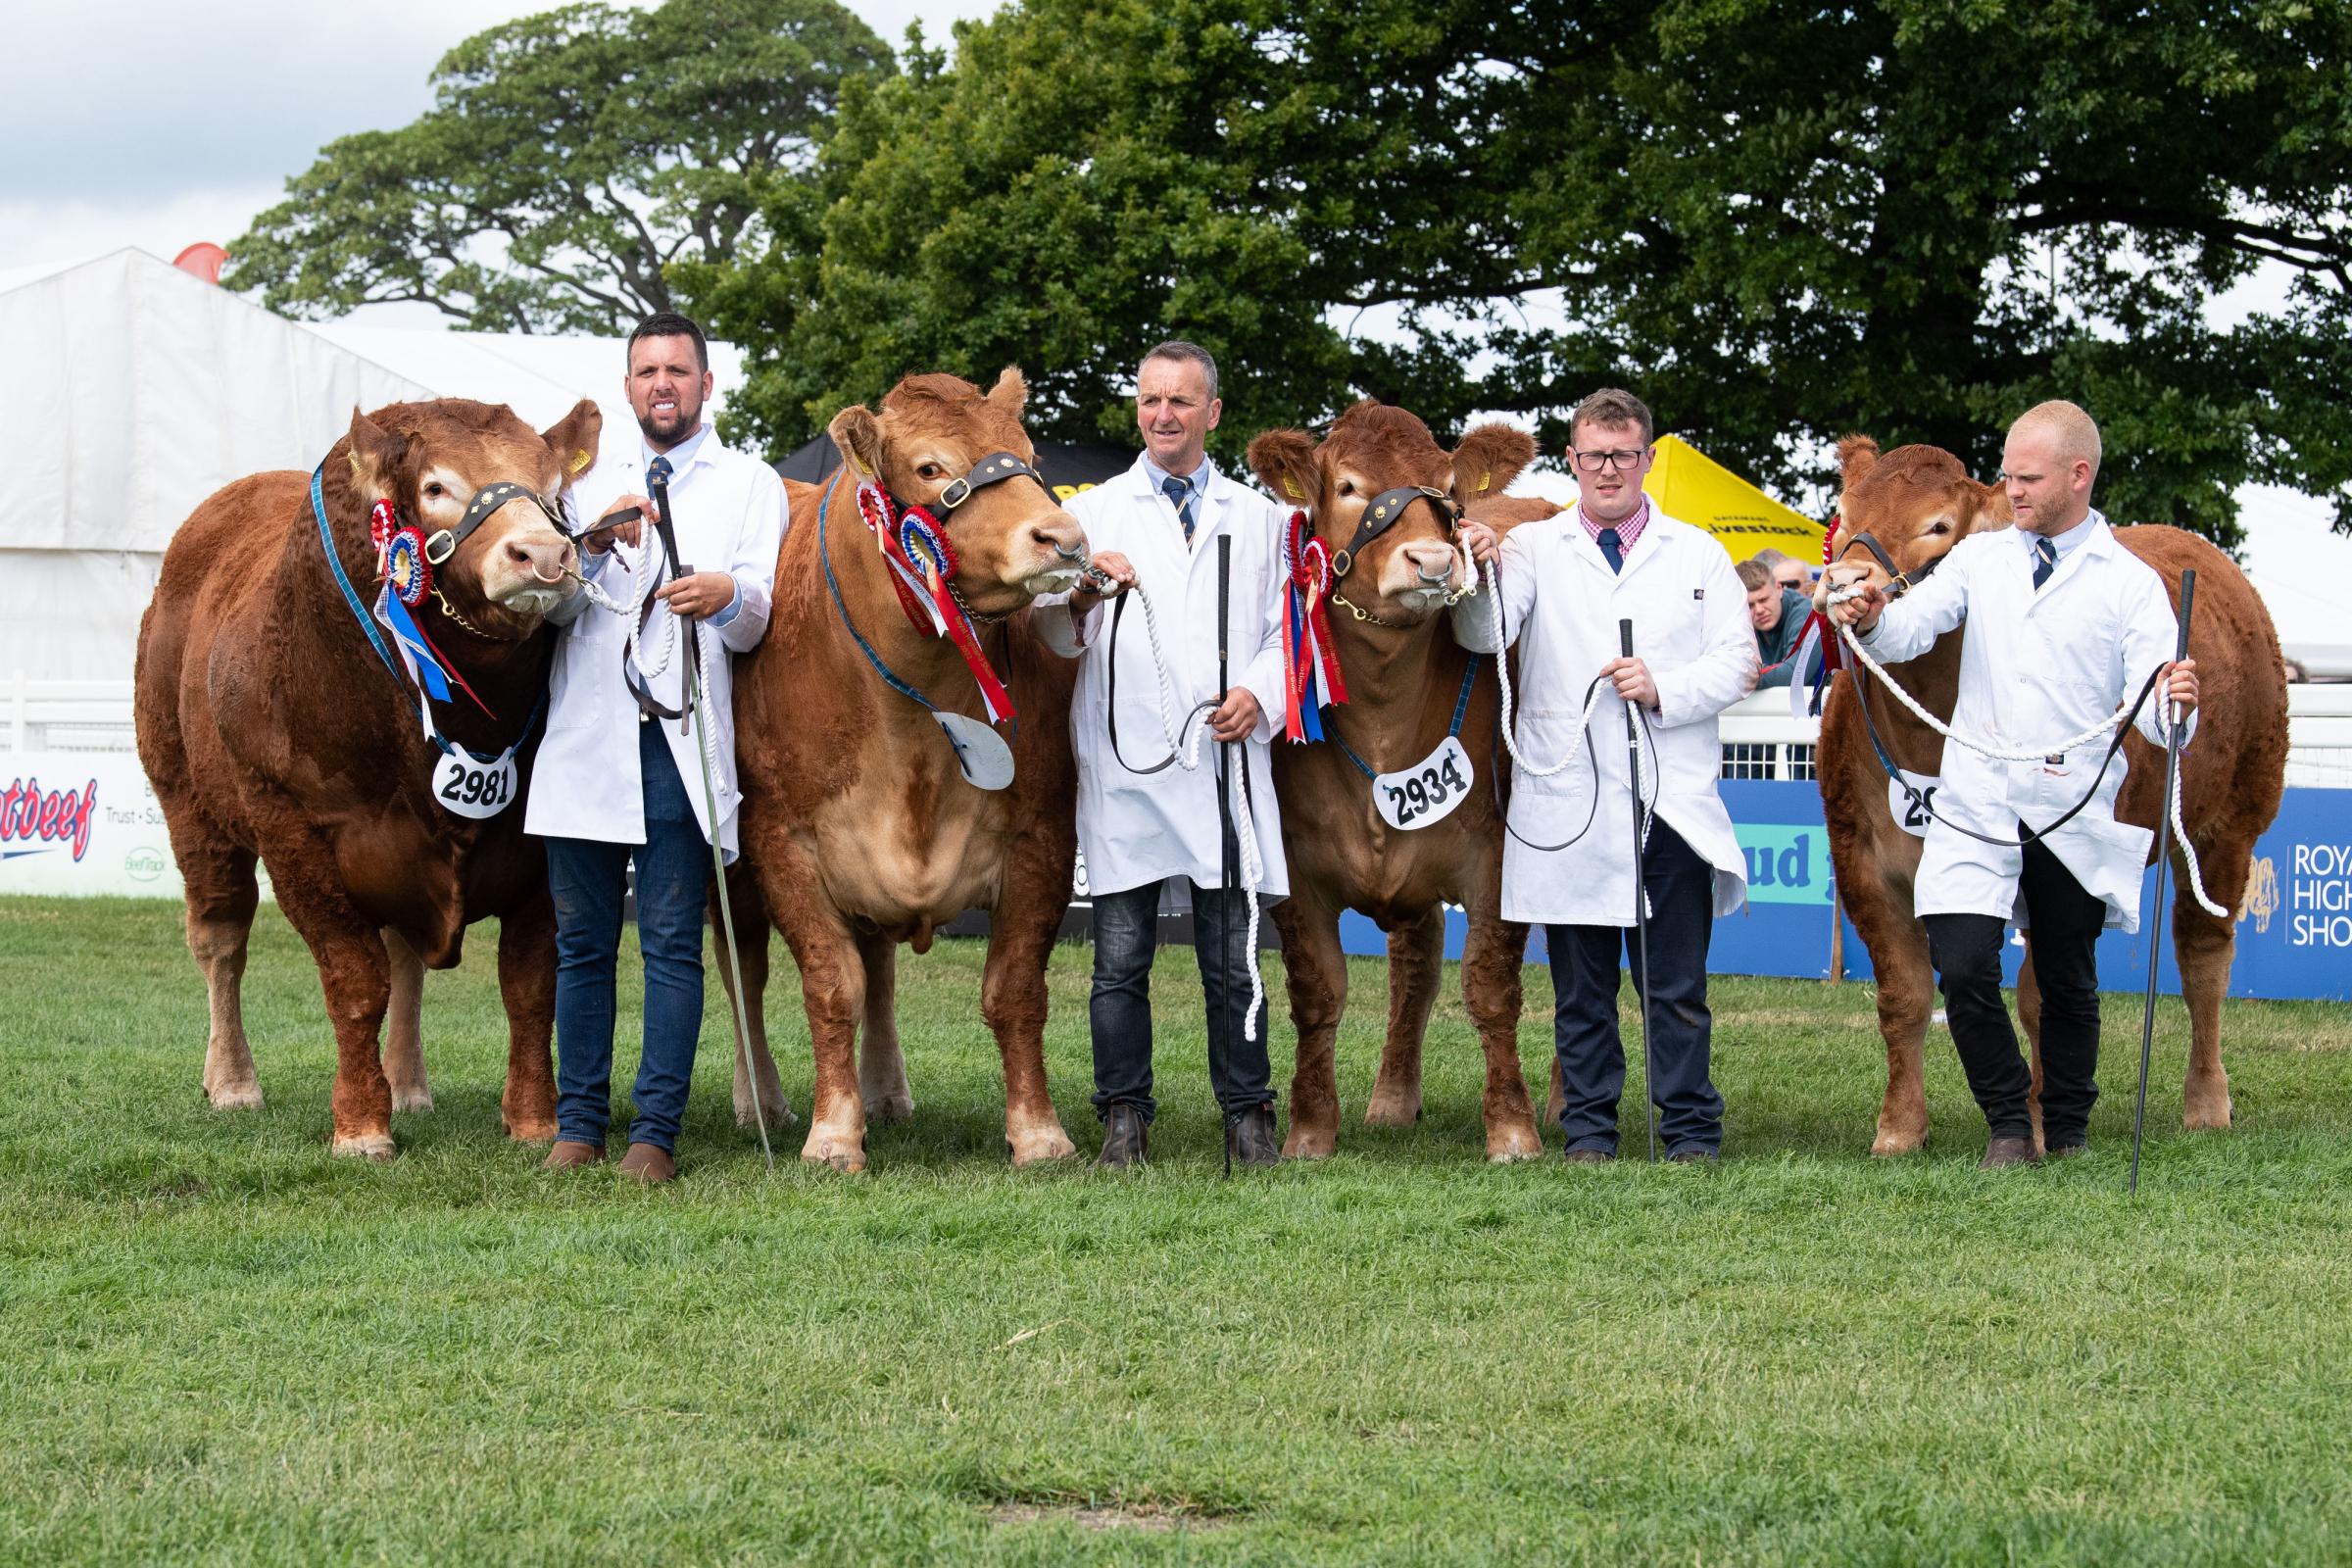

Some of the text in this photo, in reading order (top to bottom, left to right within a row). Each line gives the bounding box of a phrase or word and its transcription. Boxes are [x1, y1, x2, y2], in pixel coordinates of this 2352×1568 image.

[1708, 523, 1814, 537] ivestock
[905, 598, 927, 628] Scotland
[909, 577, 925, 595] Team
[924, 594, 941, 616] Winner
[954, 614, 968, 634] Royal
[964, 633, 984, 662] Highland
[1319, 613, 1343, 686] Royal Highland Show
[441, 763, 508, 806] 2981
[1390, 757, 1467, 825] 2934
[0, 777, 97, 862] tbeef
[107, 807, 135, 823] Trust
[1741, 833, 1810, 888] ud
[2294, 844, 2352, 876] ROY
